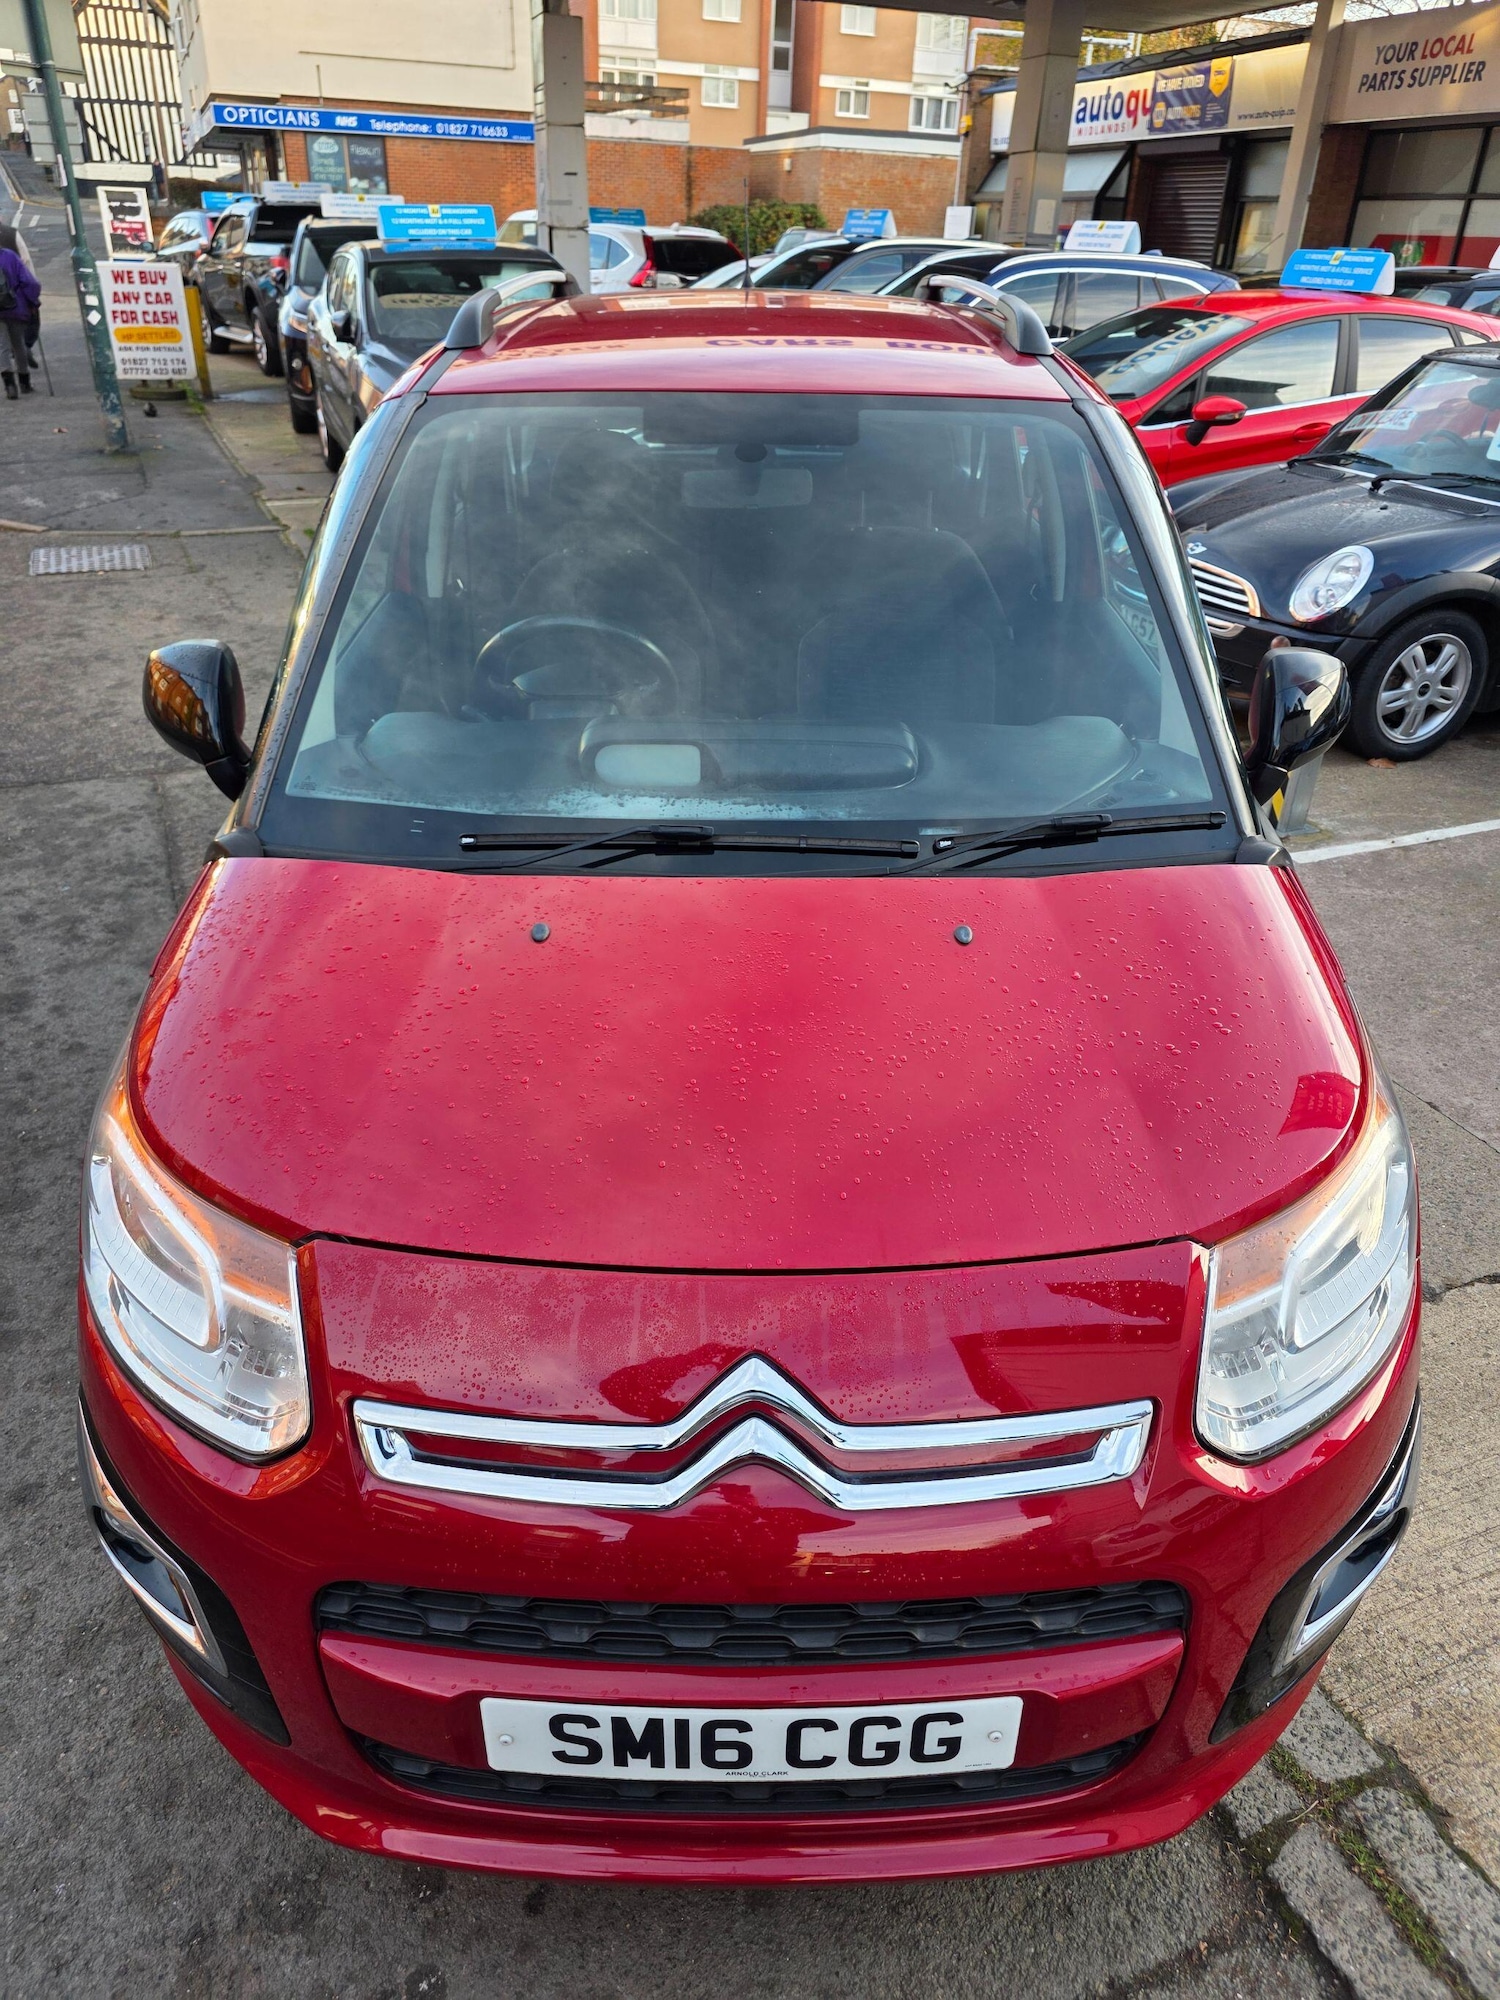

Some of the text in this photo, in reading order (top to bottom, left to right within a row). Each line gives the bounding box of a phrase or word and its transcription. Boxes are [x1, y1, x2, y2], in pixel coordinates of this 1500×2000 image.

[1375, 33, 1475, 65] YOUR LOCAL
[1358, 60, 1486, 93] PARTS SUPPLIER
[223, 106, 358, 127] OPTICIANS NHS
[369, 118, 432, 133] Telephone:
[435, 122, 468, 135] 01827
[470, 124, 508, 138] 716633
[1076, 122, 1126, 136] MIDLANDS
[111, 270, 167, 285] WE BUY
[113, 291, 173, 304] ANY CAR
[111, 310, 179, 324] FOR CASH
[137, 331, 177, 340] SETTLED
[121, 358, 148, 366] 01827
[152, 358, 168, 366] 712
[549, 1711, 964, 1770] SM16 CGG
